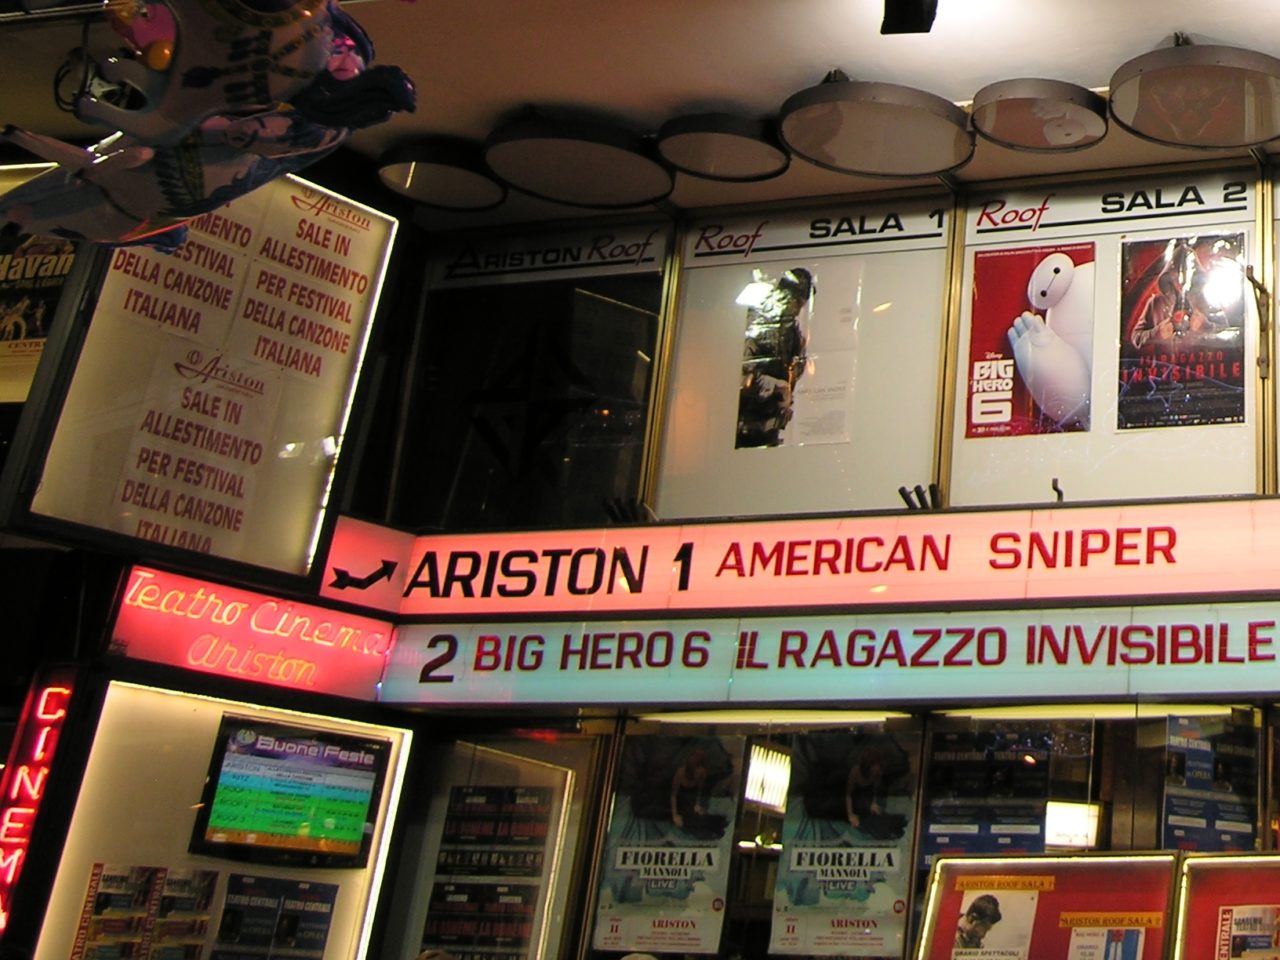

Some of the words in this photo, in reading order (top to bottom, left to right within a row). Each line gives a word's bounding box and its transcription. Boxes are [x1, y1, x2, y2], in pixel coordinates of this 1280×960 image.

[291, 194, 372, 233] Ariston
[976, 192, 1056, 232] Roof
[1101, 185, 1205, 214] SALA
[1223, 181, 1248, 203] 2
[295, 218, 333, 250] SALE
[333, 233, 352, 258] IN
[695, 220, 769, 259] Roof
[809, 212, 905, 239] SALA
[928, 208, 945, 229] 1
[258, 236, 369, 295] ALLESTIMENTO
[445, 240, 582, 280] ARISTON
[587, 229, 659, 266] Roof
[112, 248, 161, 285] DELLA
[163, 268, 234, 312] CANZONE
[256, 270, 286, 300] PER
[287, 282, 353, 325] FESTIVAL
[123, 287, 202, 334] ITALIANA
[243, 297, 286, 332] DELLA
[288, 311, 351, 355] CANZONE
[175, 354, 265, 395] Ariston
[254, 334, 323, 379] ITALIANA
[974, 359, 1015, 380] BIG
[1121, 361, 1242, 384] INVISIBILE
[972, 378, 1014, 393] HERO
[181, 387, 222, 419] SALE
[223, 400, 243, 426] IN
[972, 392, 1013, 424] 6
[139, 409, 263, 467] ALLESTIMENTO
[136, 446, 171, 478] PER
[172, 454, 245, 500] FESTIVAL
[121, 478, 170, 514] DELLA
[172, 492, 245, 533] CANZONE
[135, 518, 214, 553] ITALIANA
[402, 544, 650, 599] ARISTON
[671, 541, 695, 593] 1
[715, 534, 951, 579] AMERICAN
[987, 525, 1178, 571] SNIPER
[124, 570, 248, 626] Teatro
[250, 601, 392, 658] Cinema
[419, 634, 460, 684] 2
[473, 634, 544, 672] BIG
[736, 631, 770, 670] IL
[777, 626, 1008, 669] RAGAZZO
[1026, 620, 1276, 666] INVISIBILE
[256, 736, 319, 757] Buone
[323, 745, 376, 766] Feste
[621, 850, 715, 868] FIORELLA
[642, 867, 688, 878] MANNOIA
[795, 850, 895, 868] FIORELLA
[819, 867, 868, 880] MANNOIA
[651, 880, 676, 889] LIVE
[829, 881, 856, 890] LIVE
[652, 919, 696, 929] ARISTON
[830, 918, 878, 929] ARISTON
[1219, 909, 1233, 960] ENTRALE
